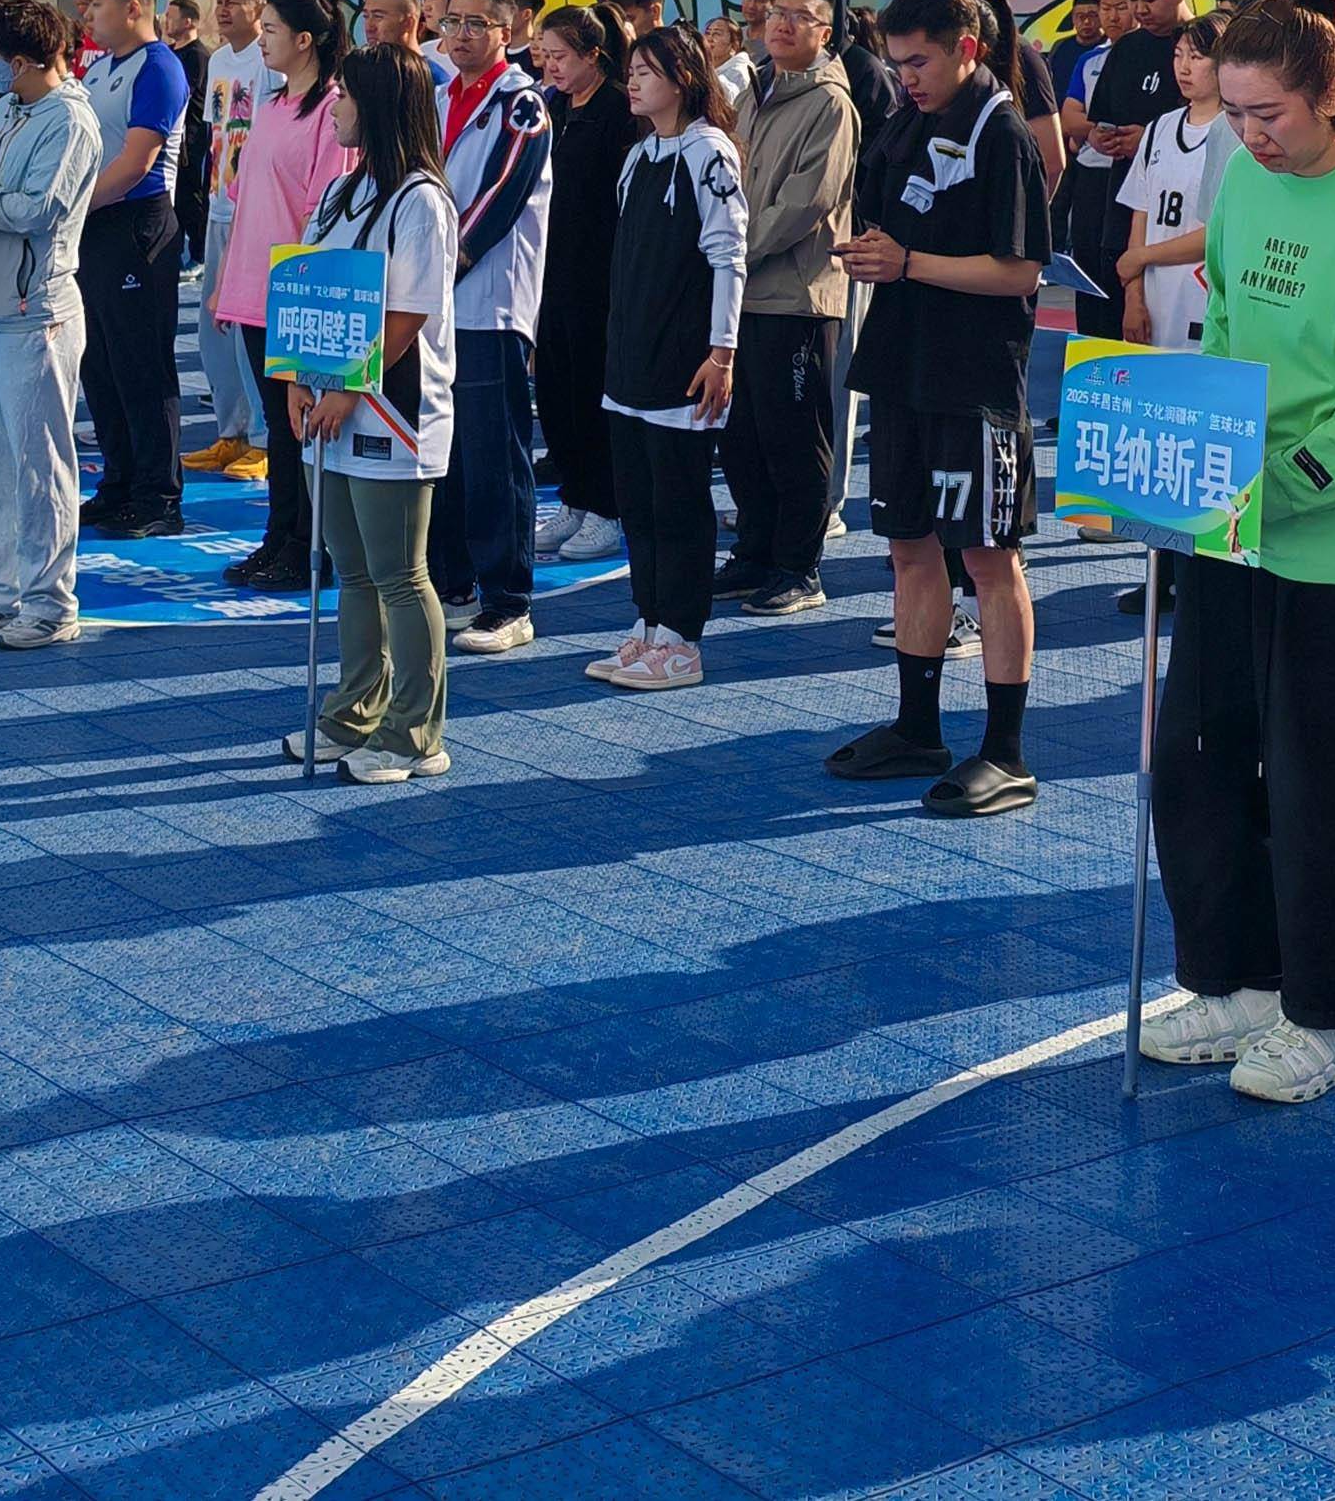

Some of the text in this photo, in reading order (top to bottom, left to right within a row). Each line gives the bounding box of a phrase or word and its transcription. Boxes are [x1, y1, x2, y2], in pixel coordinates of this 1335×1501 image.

[1156, 189, 1183, 227] 18
[1264, 255, 1298, 276] THERE
[1265, 236, 1309, 259] ARE YOU
[1240, 269, 1306, 298] ANYMORE?
[277, 306, 370, 362] 呼图壁县
[1066, 387, 1089, 405] 2025
[1090, 391, 1132, 415] 年昌吉州
[1209, 414, 1257, 439] 篮球比赛
[1075, 420, 1239, 516] 玛纳斯县
[932, 470, 973, 521] 77
